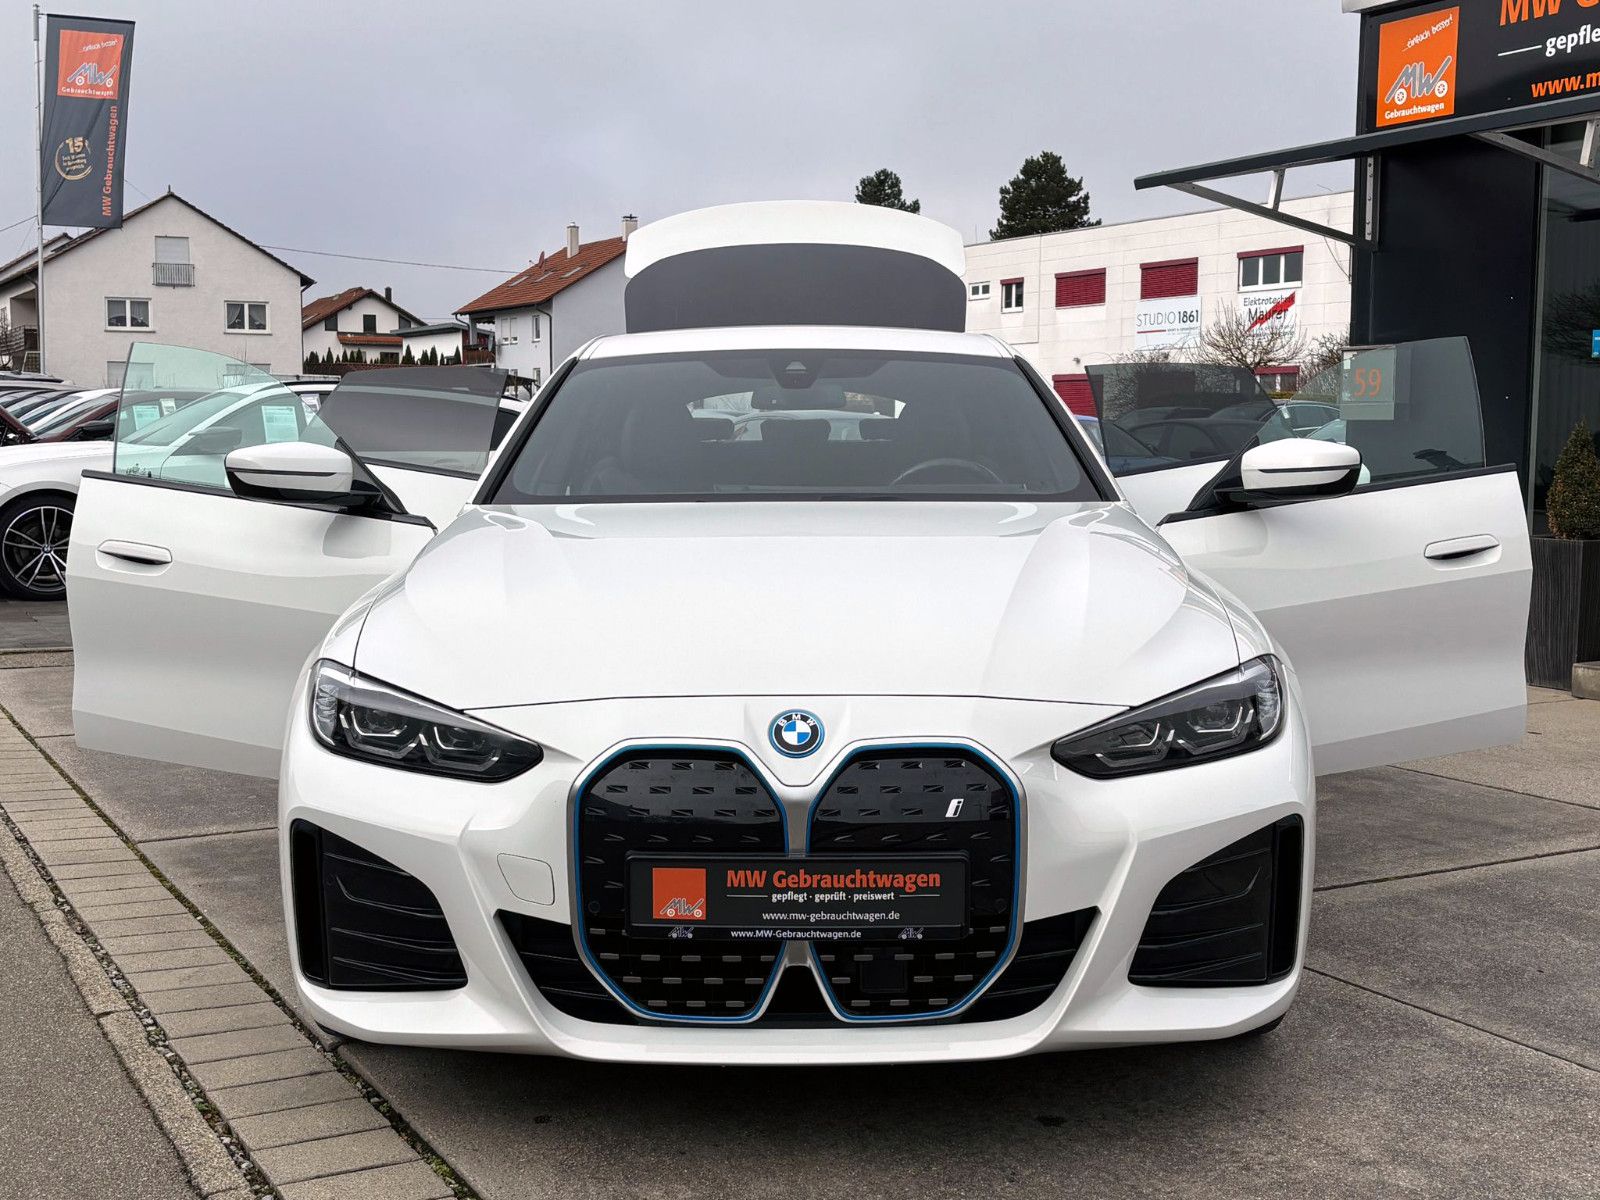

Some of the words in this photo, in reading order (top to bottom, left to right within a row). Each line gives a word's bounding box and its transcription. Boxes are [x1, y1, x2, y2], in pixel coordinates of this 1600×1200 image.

[62, 86, 114, 97] Gebrauchtwagen
[1384, 102, 1445, 120] Gebrauchtwagen
[65, 136, 84, 153] 15
[102, 105, 119, 195] Gebrauchtwagen
[102, 197, 112, 217] MW
[1136, 311, 1176, 327] STUDIO
[1177, 309, 1199, 324] 1861
[1354, 367, 1382, 398] 59
[777, 714, 817, 727] BMW
[727, 870, 767, 888] MW
[772, 868, 941, 893] Gebrauchtwagen
[771, 891, 808, 903] gepflegt
[814, 891, 847, 903] geprüft
[853, 891, 895, 903] preiswert
[762, 910, 901, 923] www.mw-gebrauchtwagen.de
[730, 929, 862, 940] www.MW-Gebrauchtwagen.de
